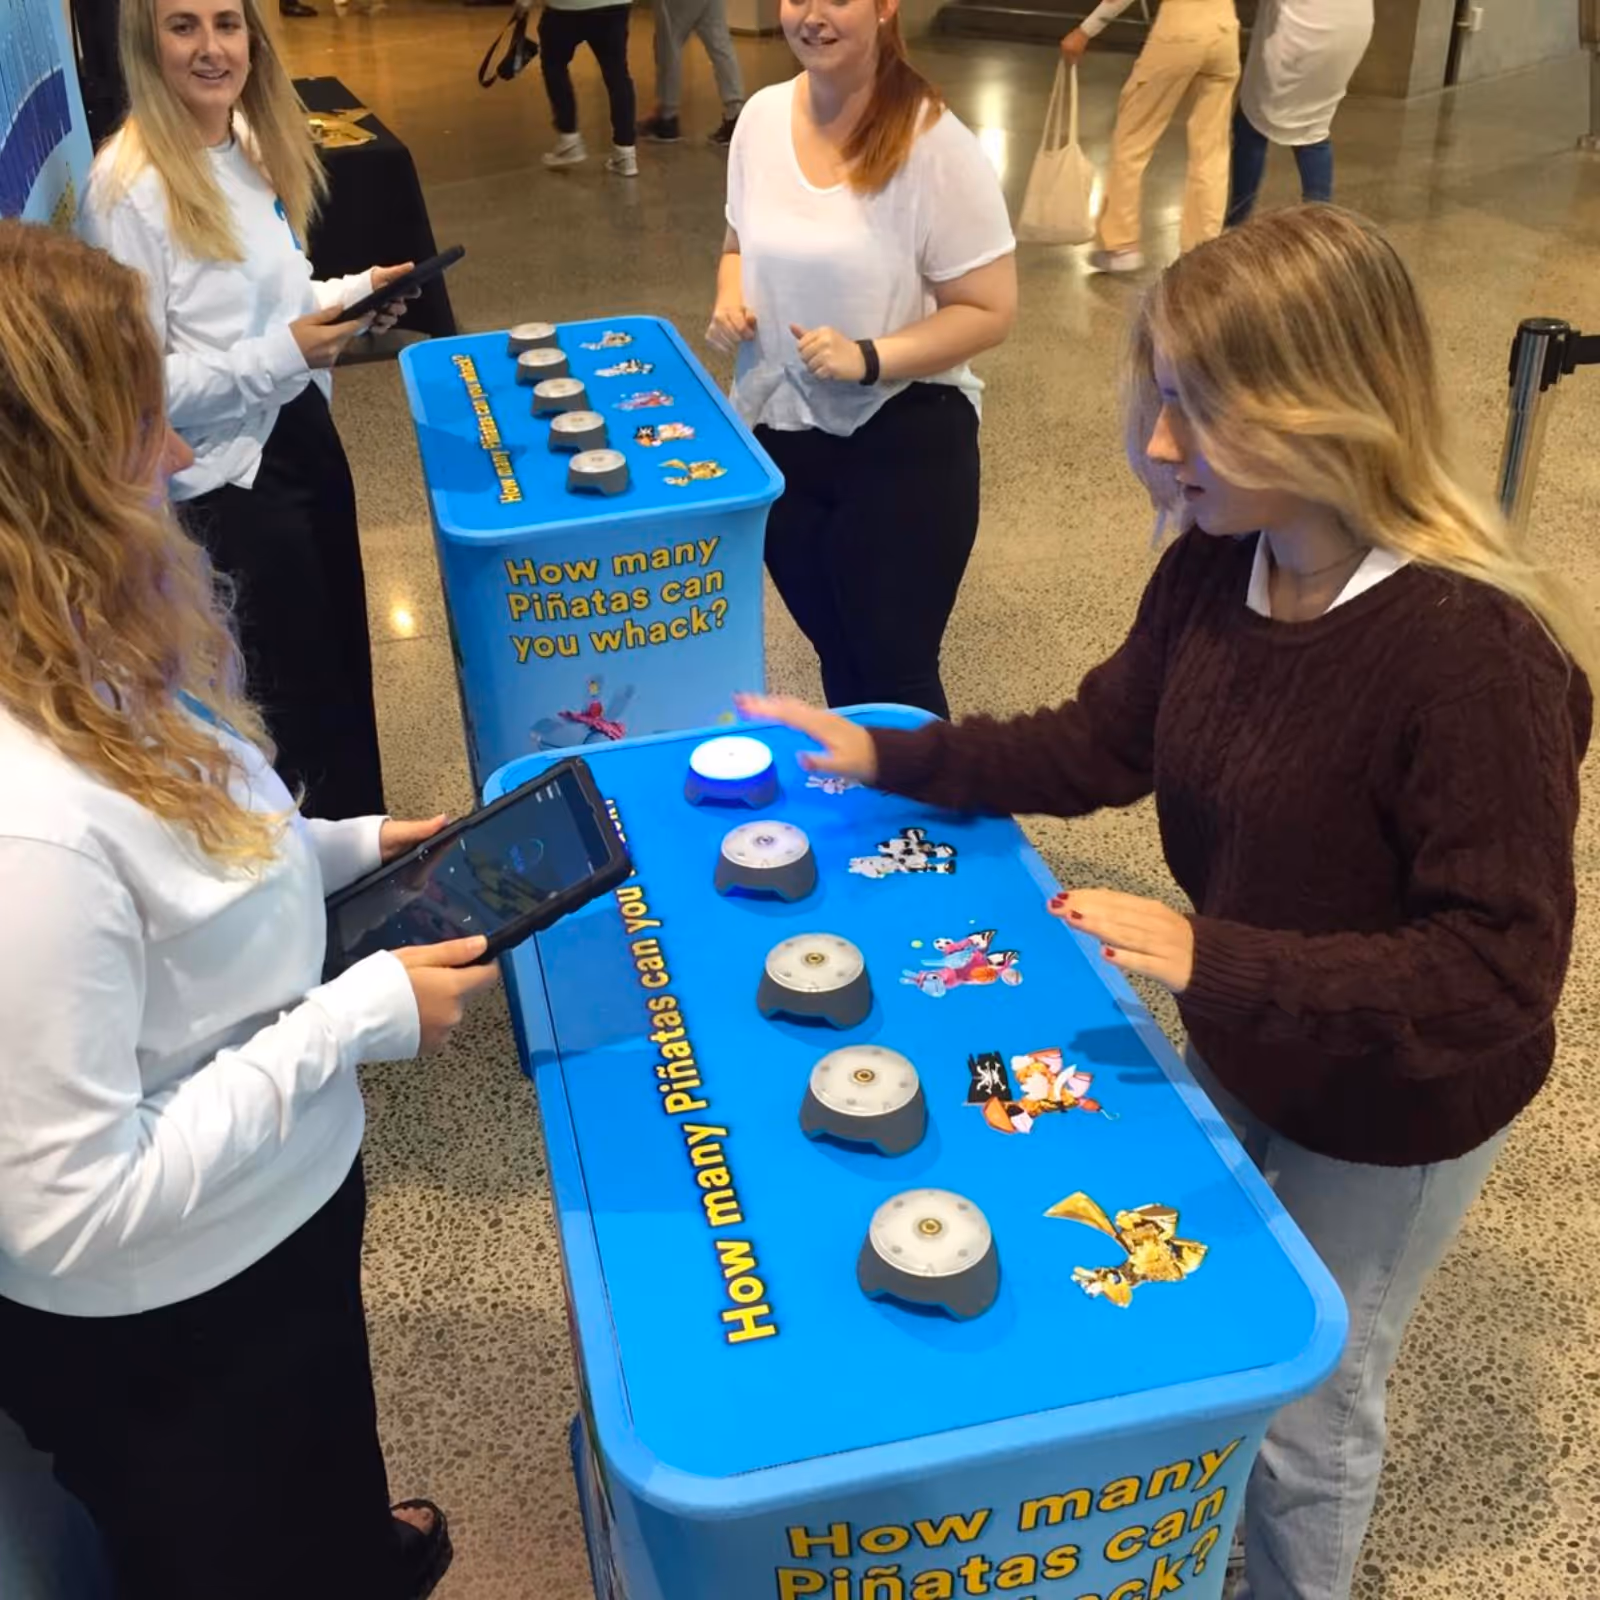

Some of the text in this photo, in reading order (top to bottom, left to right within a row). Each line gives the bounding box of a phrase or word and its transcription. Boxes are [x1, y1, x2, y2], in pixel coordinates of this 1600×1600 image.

[505, 535, 720, 587] How many
[506, 570, 724, 622] Piñatas can
[511, 597, 728, 664] you whack?
[615, 885, 662, 935] you
[631, 938, 671, 989] can
[649, 995, 708, 1116] Piñatas
[683, 1123, 743, 1227] many
[715, 1240, 777, 1344] How
[786, 1435, 1247, 1559] How many
[775, 1486, 1228, 1600] Piñatas can
